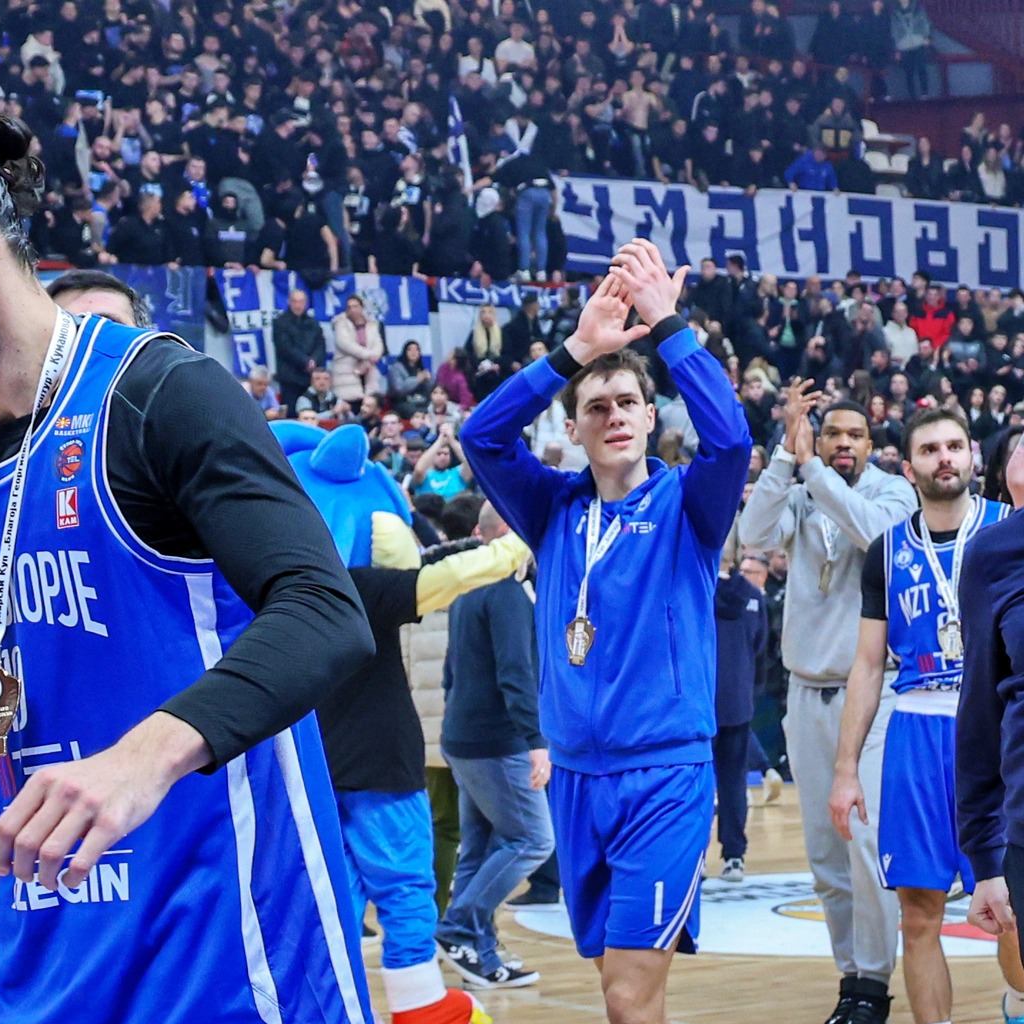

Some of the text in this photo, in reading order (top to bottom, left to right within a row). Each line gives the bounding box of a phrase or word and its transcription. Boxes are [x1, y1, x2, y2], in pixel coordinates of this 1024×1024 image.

[0, 555, 9, 576] Куп
[898, 582, 931, 627] MZT
[654, 881, 664, 925] 1
